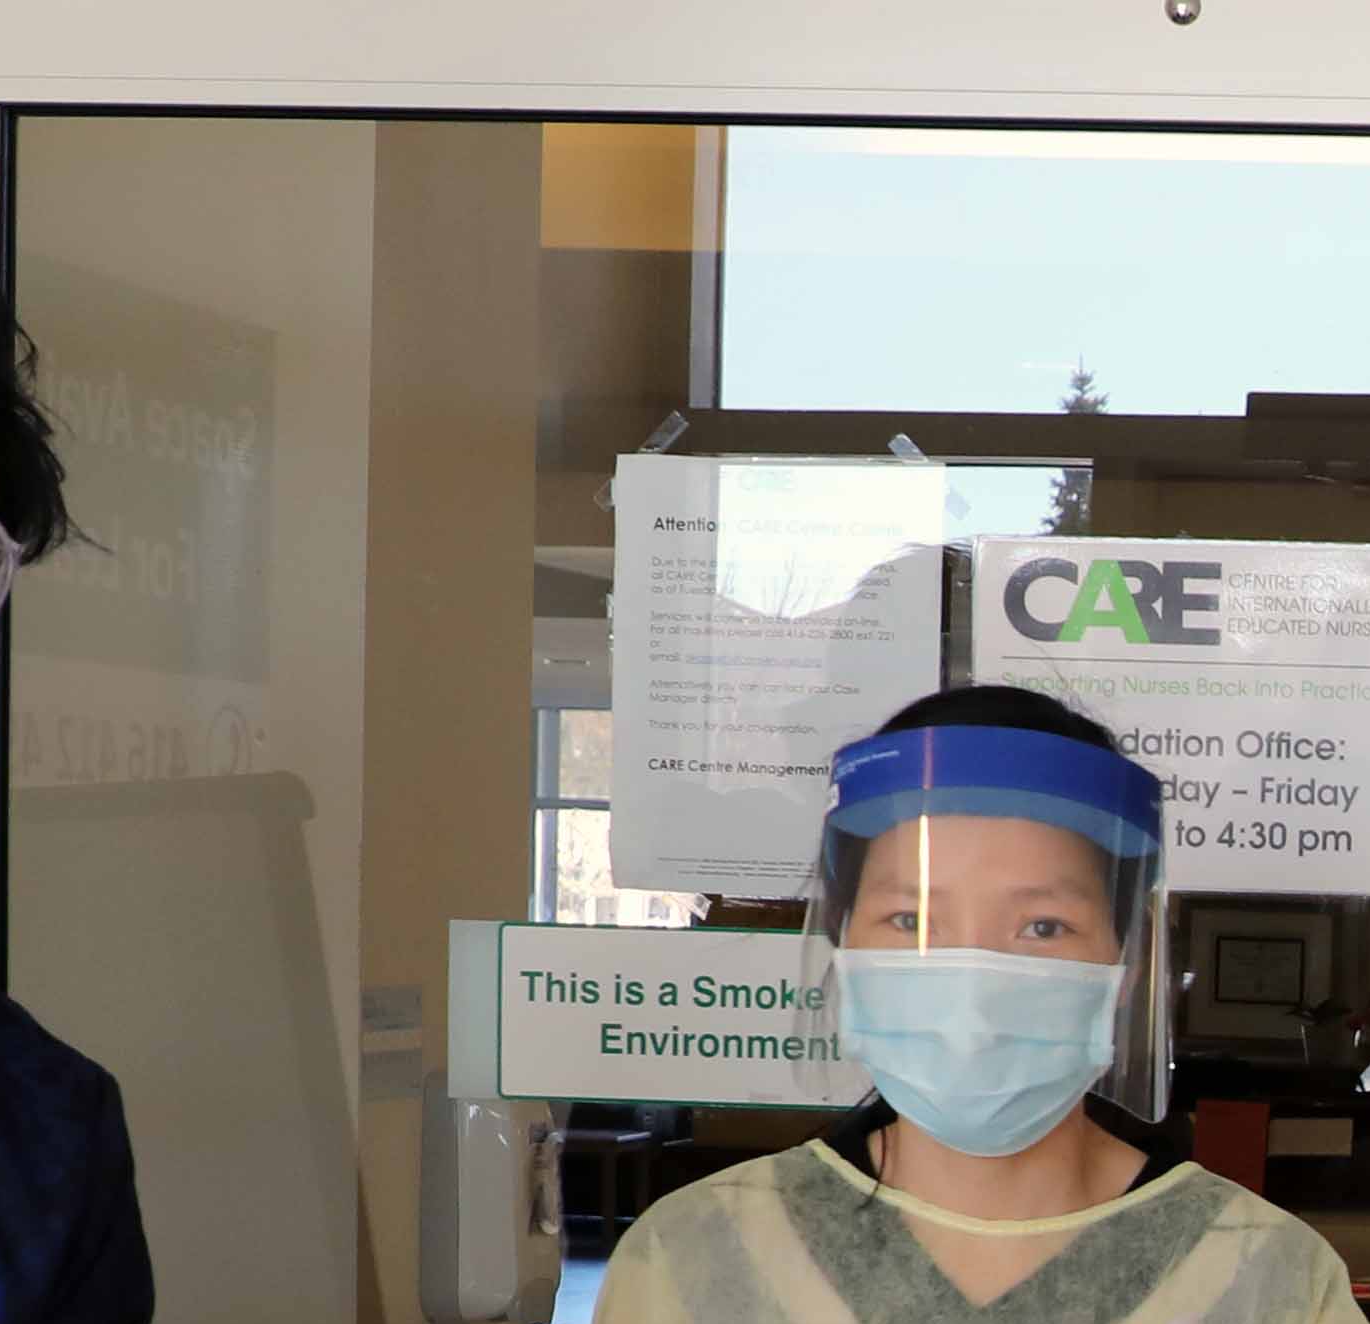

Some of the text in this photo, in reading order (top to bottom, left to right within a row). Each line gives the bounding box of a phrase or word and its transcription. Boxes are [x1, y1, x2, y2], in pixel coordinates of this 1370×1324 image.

[653, 516, 726, 533] Attentio
[1228, 573, 1295, 591] CENTRE
[1003, 558, 1222, 645] CARE
[1227, 617, 1320, 636] EDUCATED
[1001, 672, 1115, 697] Supporting
[1125, 675, 1190, 695] Nurses
[1197, 677, 1247, 698] Back
[1255, 680, 1294, 698] Into
[1236, 730, 1346, 761] Office:
[648, 758, 685, 771] CARE
[688, 758, 734, 773] Centre
[737, 760, 829, 778] Management
[1260, 776, 1359, 813] Friday
[1176, 821, 1353, 857] to 4:30 pm
[520, 971, 825, 1011] This is a Smoke
[600, 1023, 842, 1062] Environment
